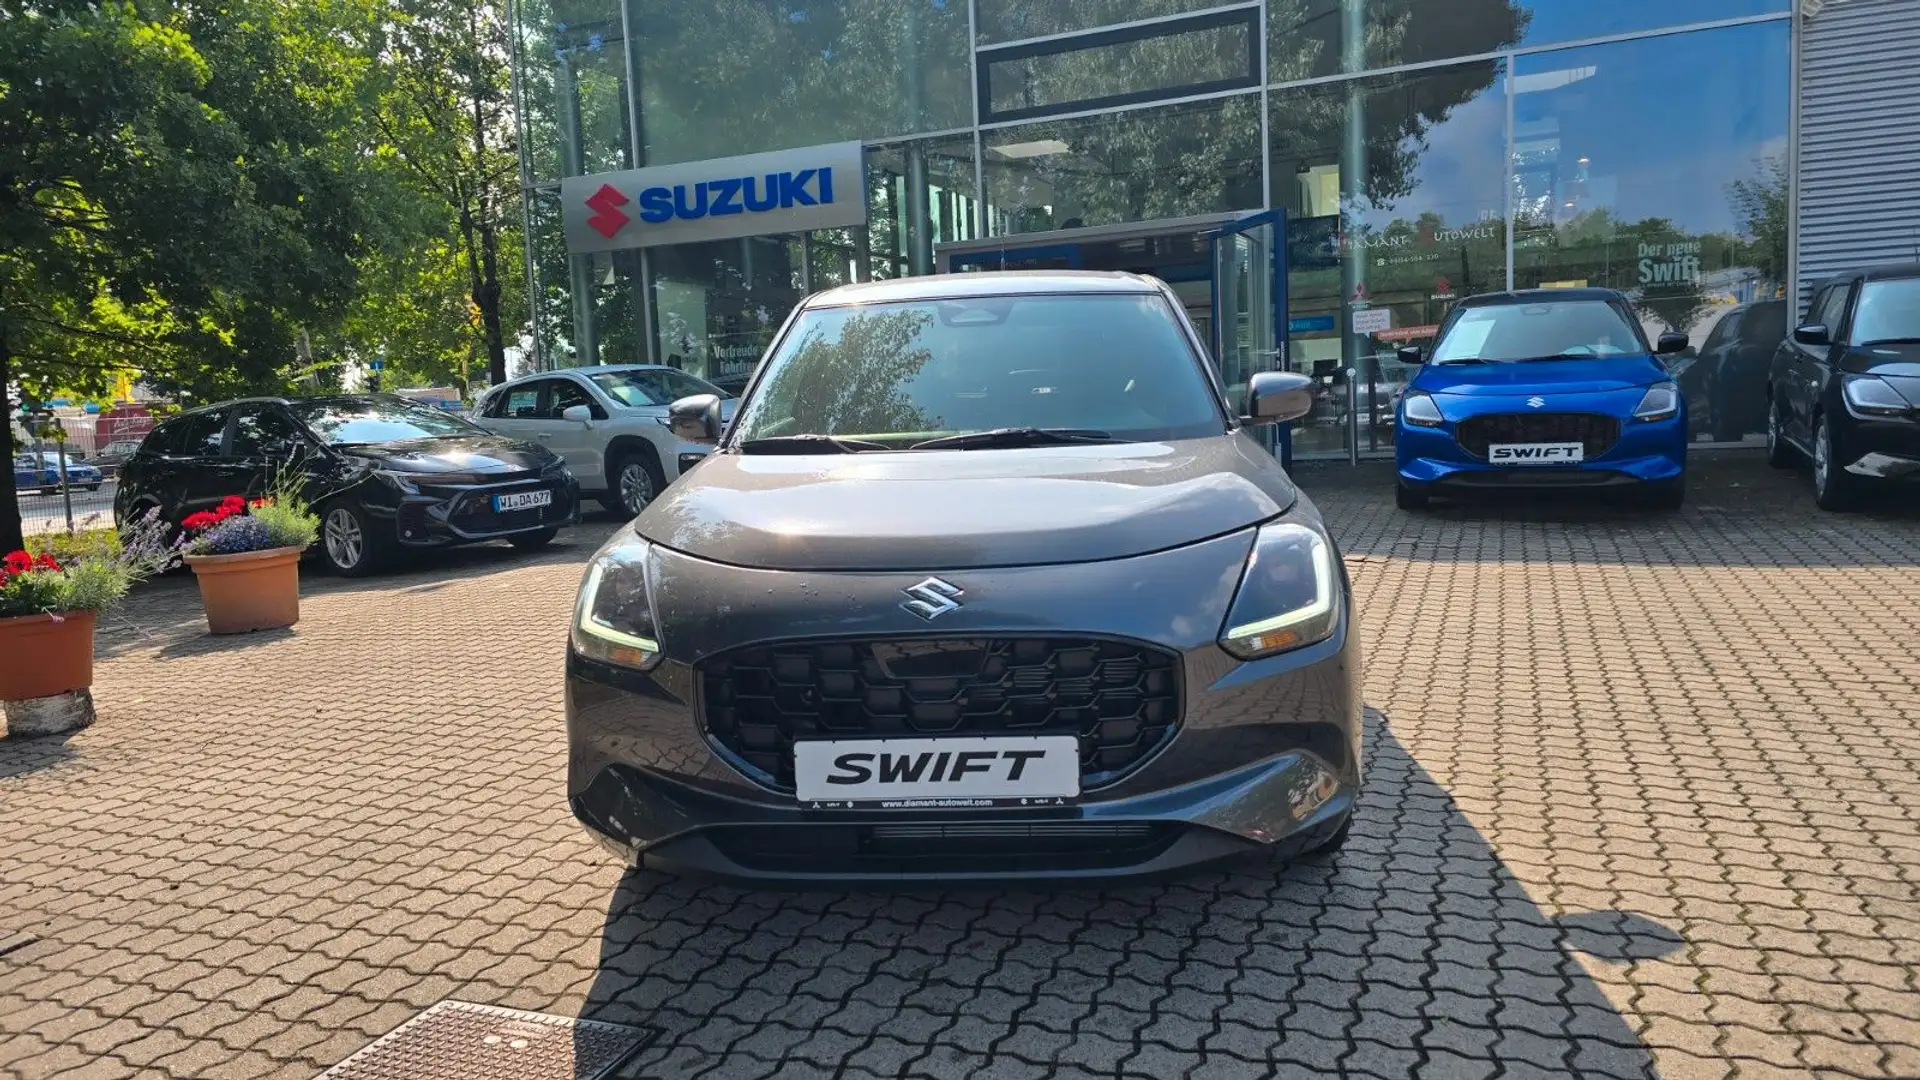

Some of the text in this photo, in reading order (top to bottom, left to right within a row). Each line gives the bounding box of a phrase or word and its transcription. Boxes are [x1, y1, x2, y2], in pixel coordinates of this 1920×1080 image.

[639, 167, 833, 223] SUZUKI
[1638, 241, 1701, 257] Der neue
[1638, 254, 1701, 283] Swift
[1493, 447, 1579, 459] SWIFT
[826, 750, 1046, 785] SWIFT
[881, 798, 993, 808] www.diamant-autowelt.com
